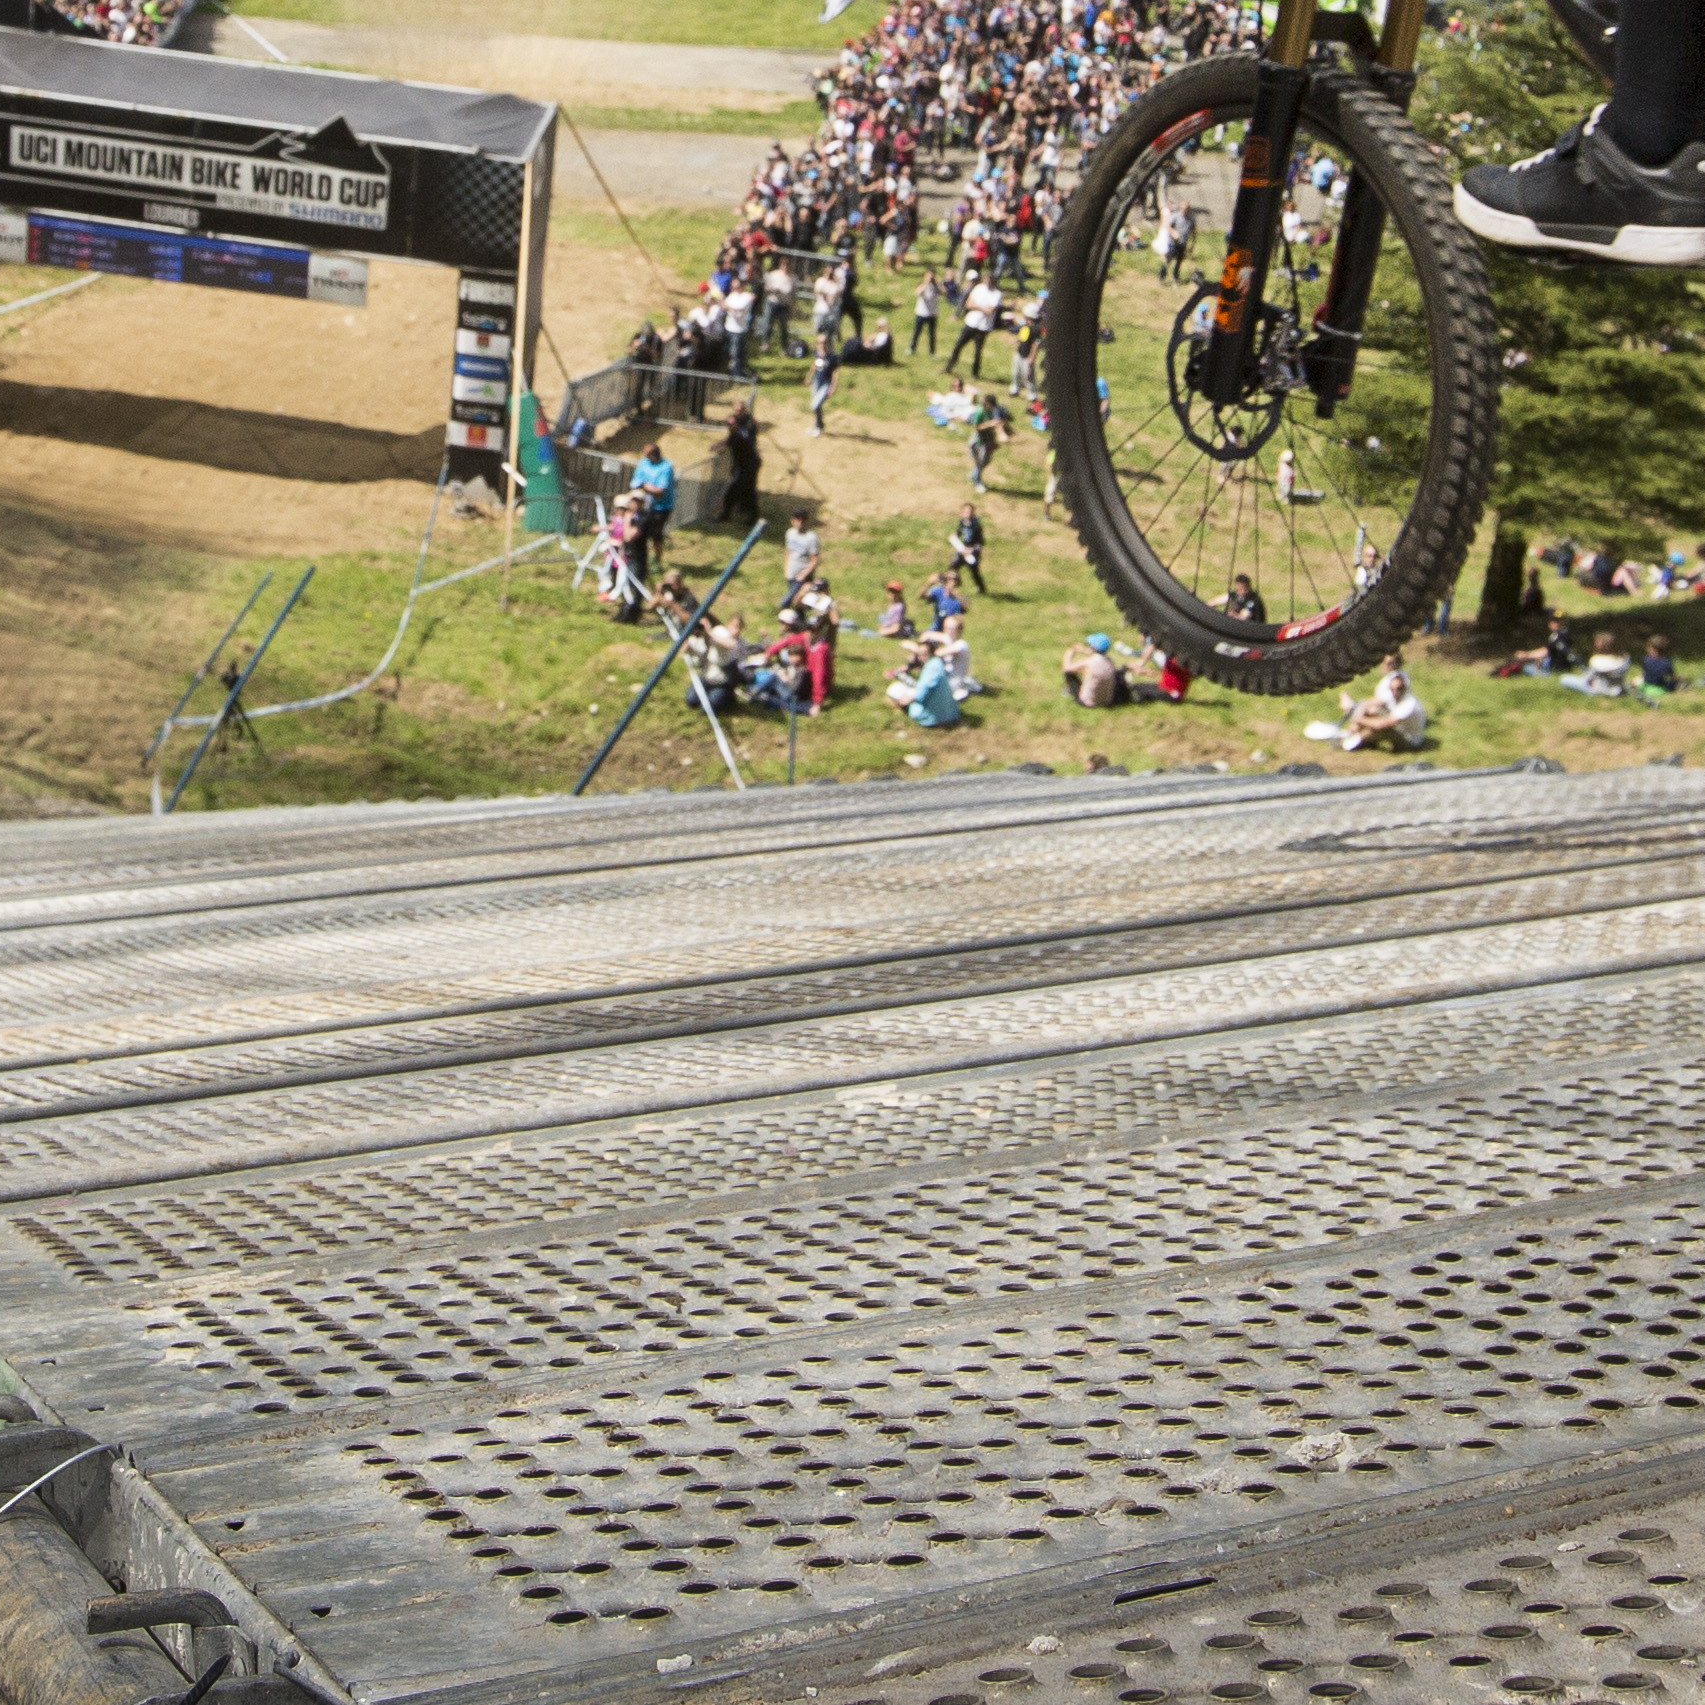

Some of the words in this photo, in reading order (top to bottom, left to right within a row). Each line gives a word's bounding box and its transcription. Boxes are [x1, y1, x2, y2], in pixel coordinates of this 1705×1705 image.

[19, 133, 57, 164] UCI
[63, 138, 184, 182] MOUNTAIN
[190, 156, 241, 190] BIKE
[252, 164, 333, 202] WORLD
[339, 177, 386, 209] CUP
[288, 201, 383, 228] SHIMANO
